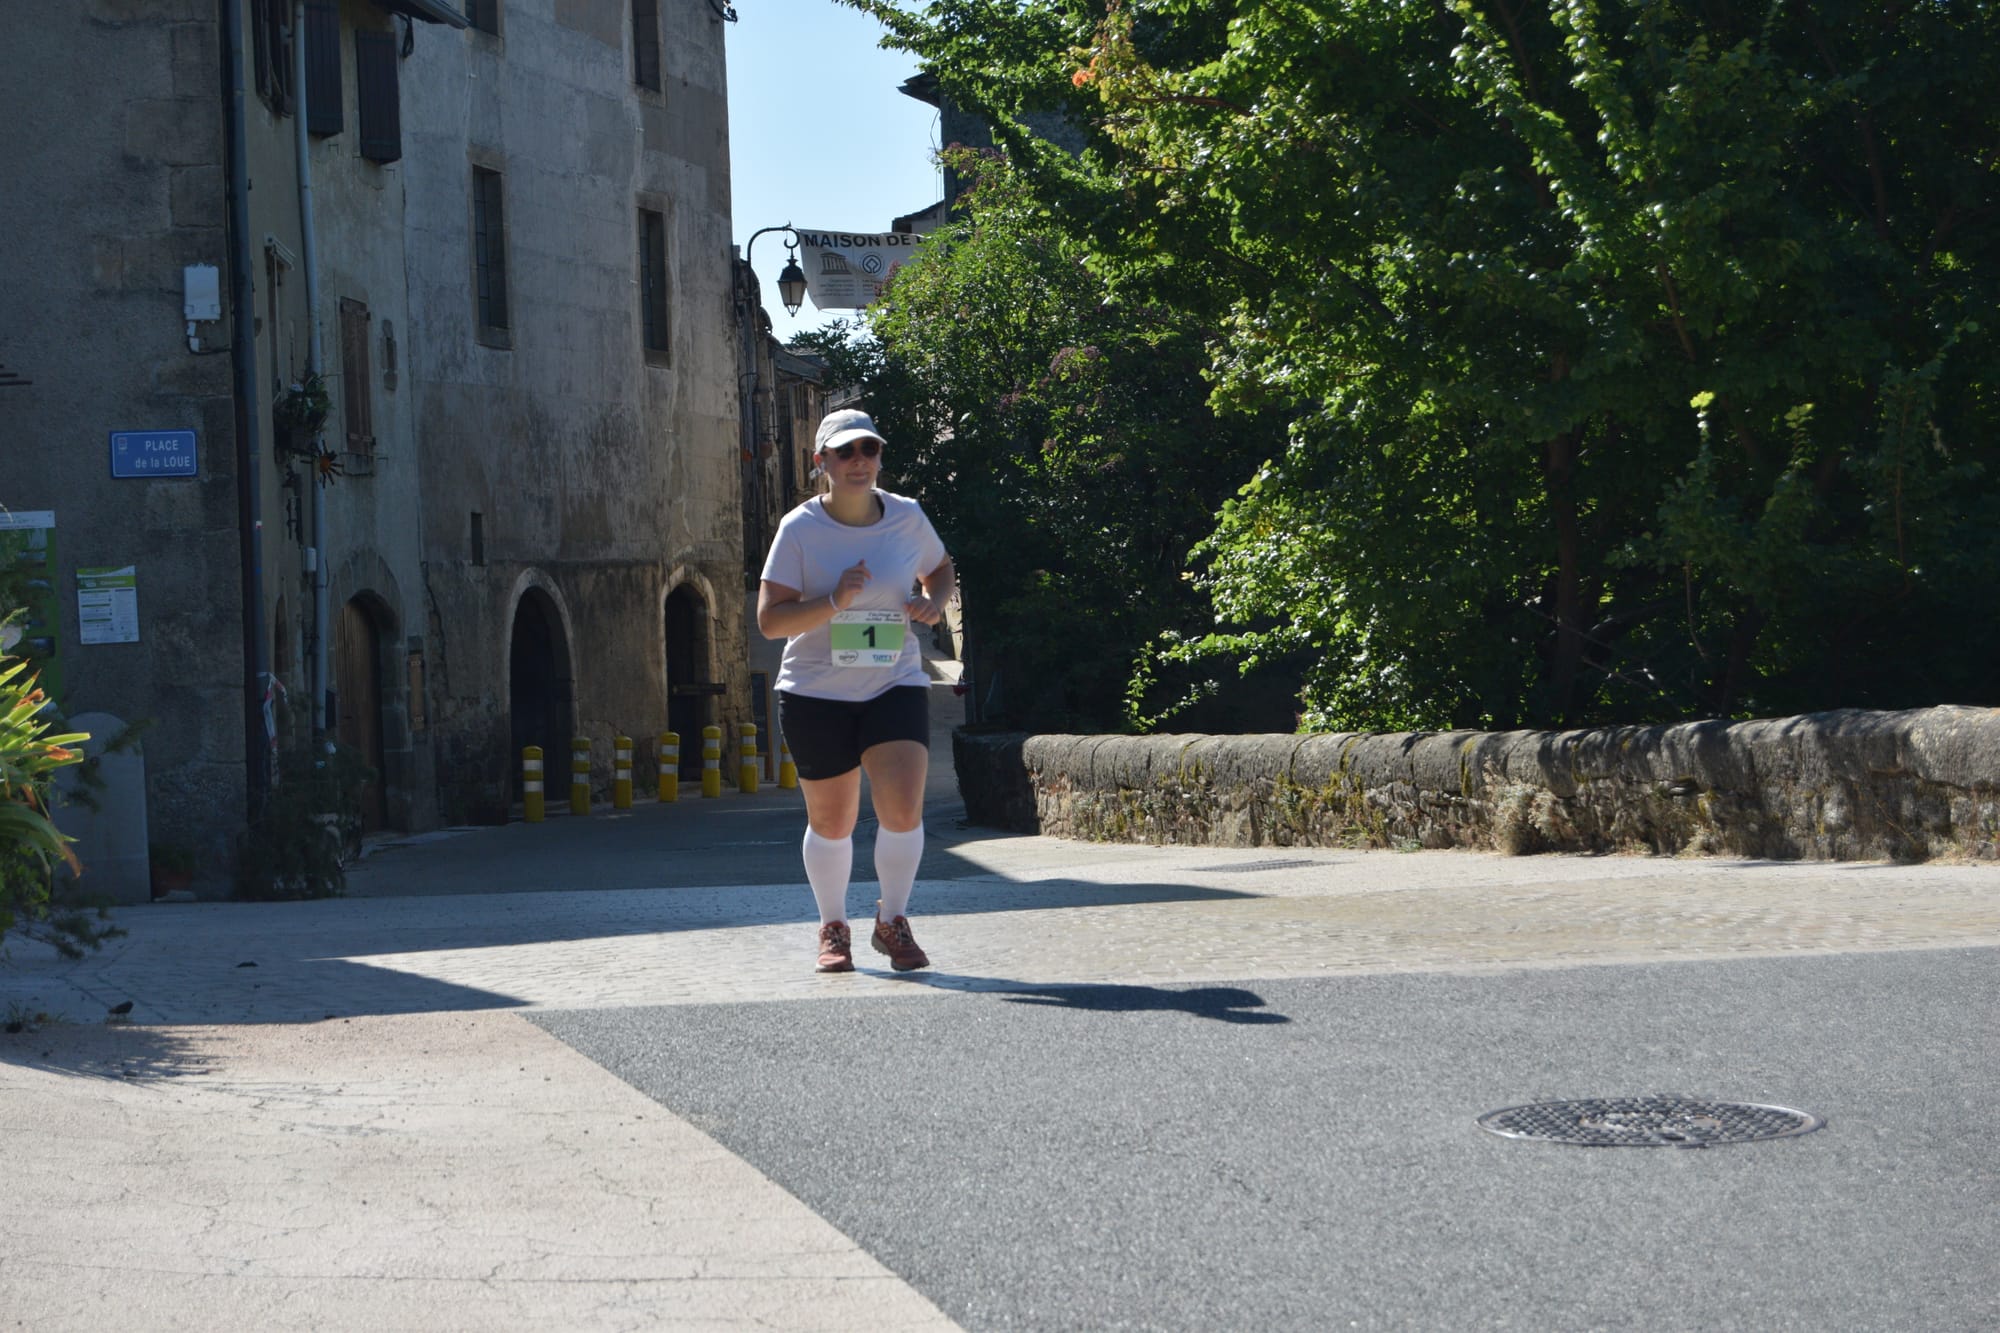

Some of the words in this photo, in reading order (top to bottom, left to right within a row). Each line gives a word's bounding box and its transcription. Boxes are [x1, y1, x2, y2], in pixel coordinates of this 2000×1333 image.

[803, 234, 881, 248] MAISON
[886, 235, 911, 247] DE
[145, 440, 179, 451] PLACE
[135, 457, 147, 469] de
[150, 457, 160, 468] la
[163, 456, 191, 468] LOUE
[862, 625, 875, 648] 1
